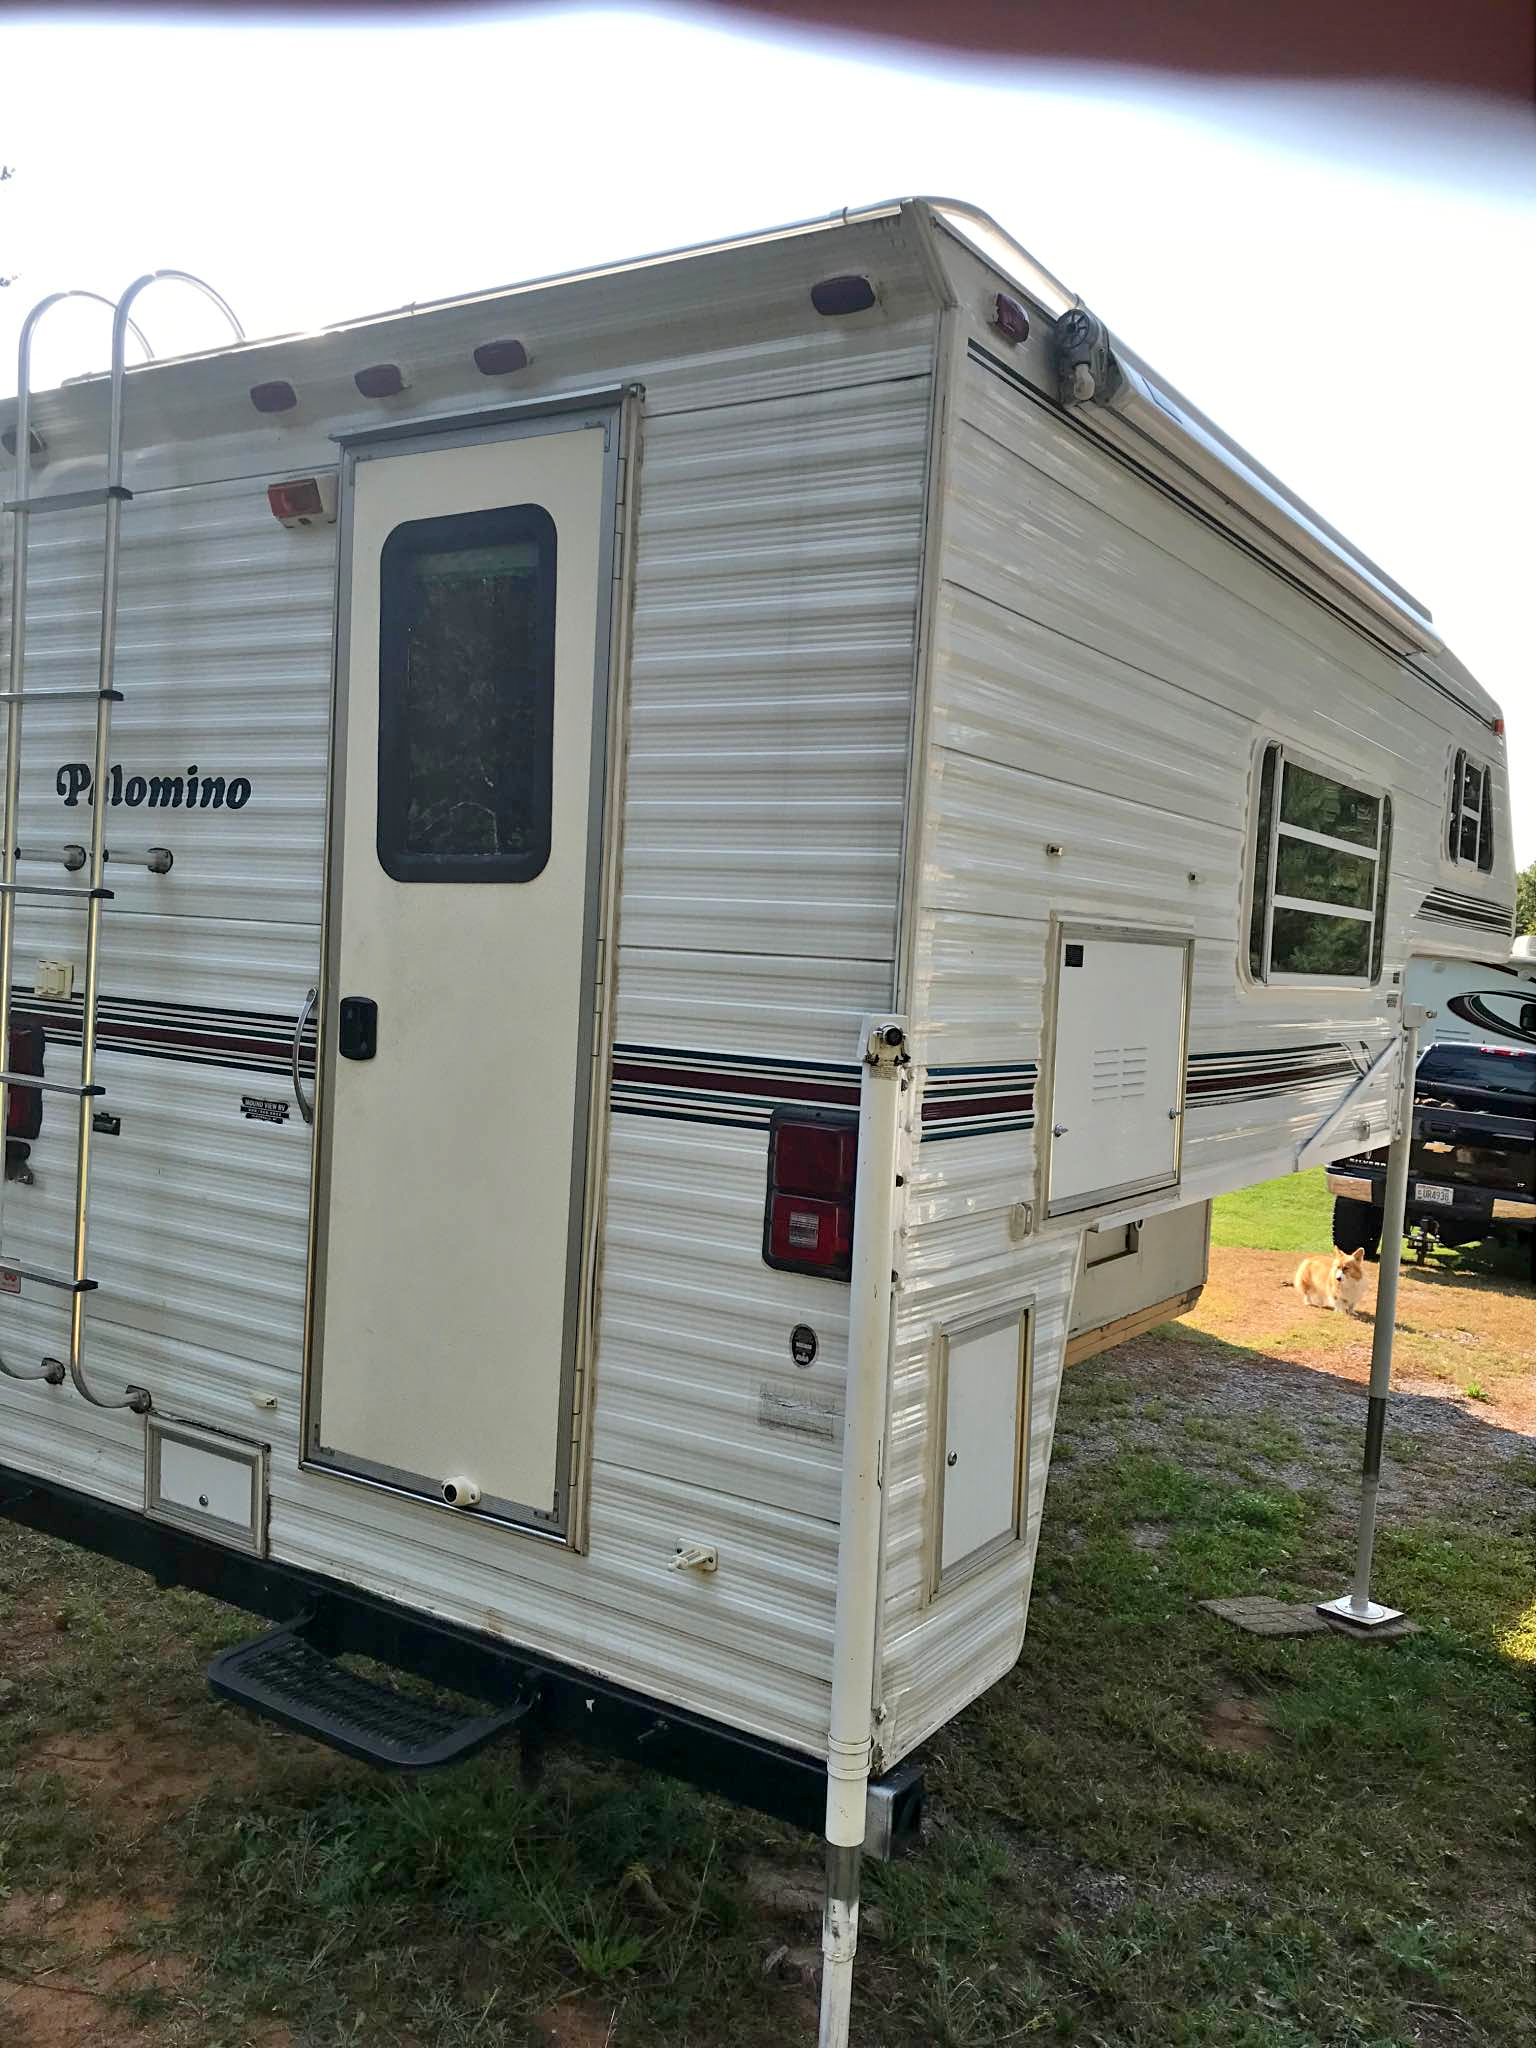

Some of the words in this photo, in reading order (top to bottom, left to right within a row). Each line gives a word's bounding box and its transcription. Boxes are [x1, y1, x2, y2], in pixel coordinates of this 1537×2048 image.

[56, 763, 252, 809] Plomino
[245, 1099, 264, 1108] MOUND
[264, 1102, 278, 1110] VIEW
